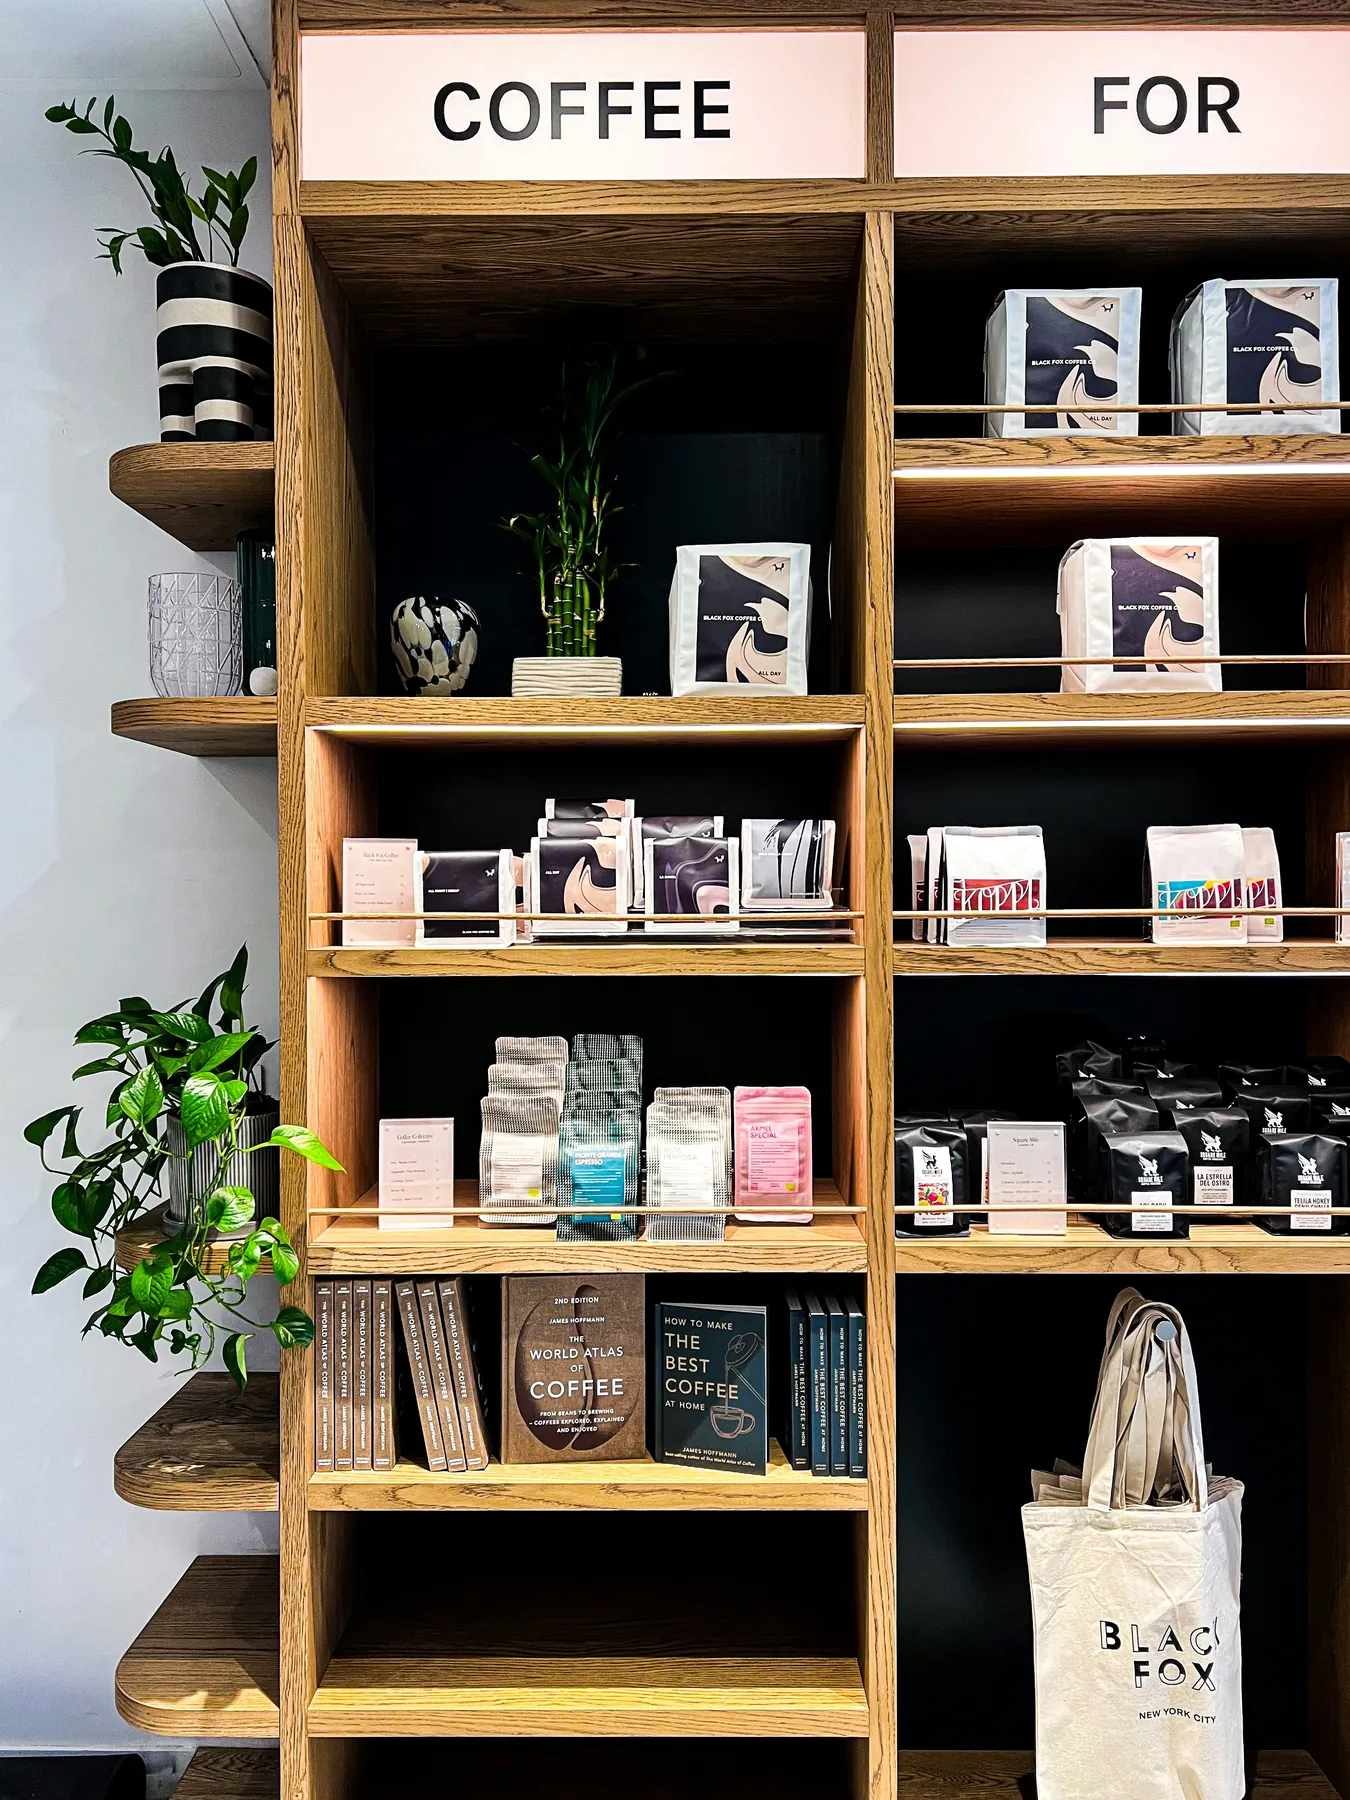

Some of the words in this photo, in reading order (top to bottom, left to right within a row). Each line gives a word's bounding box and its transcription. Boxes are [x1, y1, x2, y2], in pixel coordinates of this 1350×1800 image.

[434, 81, 731, 141] COFFEE
[1094, 75, 1242, 135] FOR
[429, 1312, 438, 1338] WORLD
[449, 1311, 458, 1337] WORLD
[664, 1317, 686, 1326] HOW
[690, 1320, 703, 1328] TO
[707, 1321, 733, 1330] MAKE
[433, 1340, 442, 1361] ATLAS
[453, 1339, 461, 1361] ATLAS
[665, 1333, 700, 1350] THE
[800, 1337, 804, 1345] TO
[858, 1343, 862, 1351] TO
[408, 1312, 417, 1338] WORLD
[413, 1339, 421, 1361] ATLAS
[419, 1371, 429, 1398] COFFEE
[530, 1348, 579, 1360] WORLD
[583, 1347, 624, 1358] ATLAS
[665, 1355, 710, 1373] BEST
[570, 1365, 584, 1373] OF
[439, 1372, 448, 1399] COFFEE
[458, 1370, 468, 1398] COFFEE
[529, 1378, 624, 1399] COFFEE
[665, 1378, 738, 1400] COFFEE
[665, 1400, 676, 1408] AT
[679, 1402, 705, 1411] HOME
[703, 1449, 737, 1458] HOFFMANN
[1133, 1658, 1216, 1691] FOX
[1140, 1709, 1161, 1720] NEW
[1163, 1708, 1191, 1718] YORK
[1193, 1714, 1216, 1724] CITY
